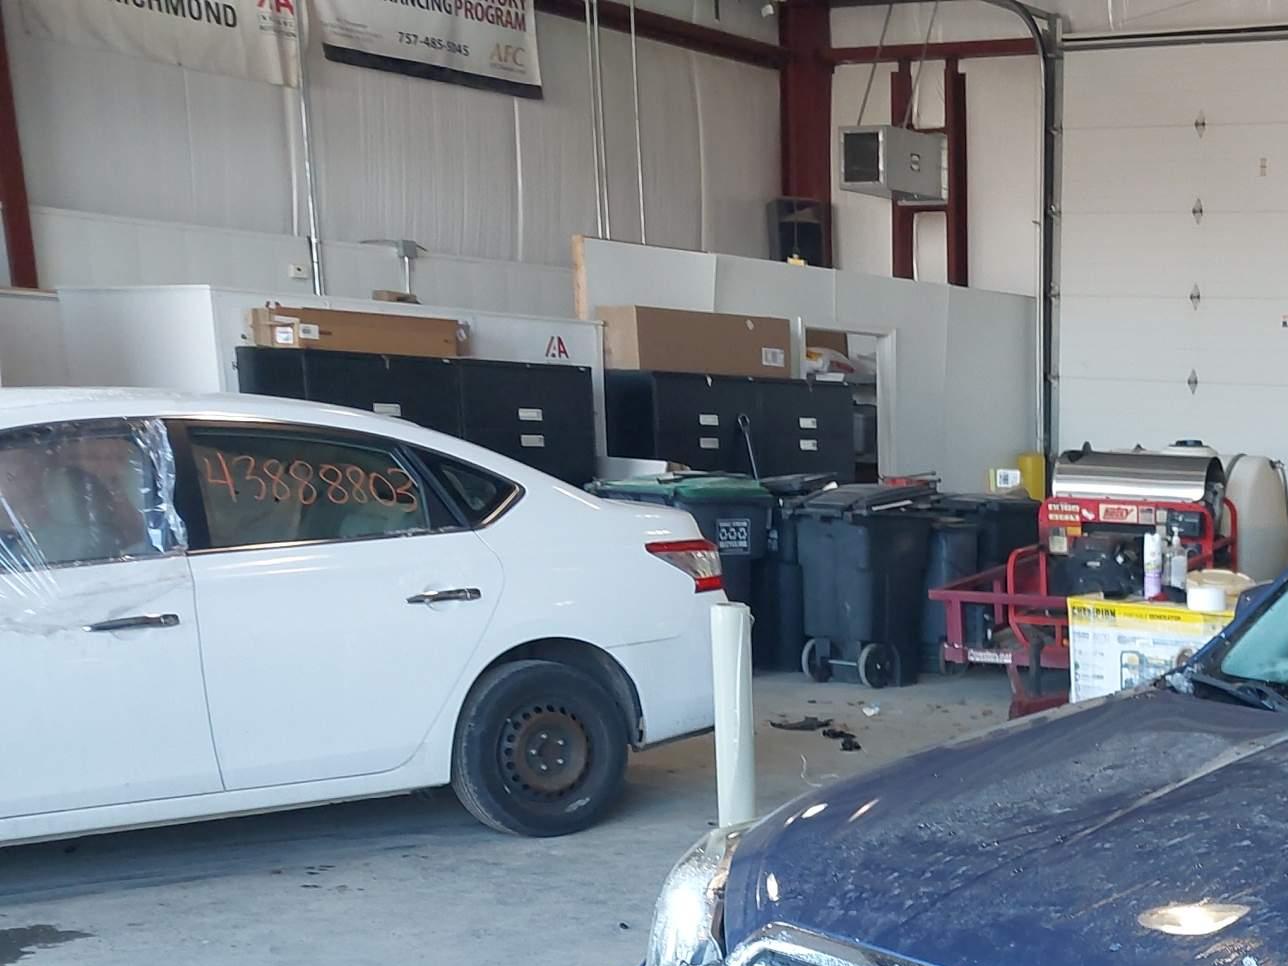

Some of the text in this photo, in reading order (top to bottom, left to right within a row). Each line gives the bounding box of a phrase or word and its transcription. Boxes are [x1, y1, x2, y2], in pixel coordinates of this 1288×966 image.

[455, 0, 526, 32] PROGRAM
[489, 42, 526, 67] AFC
[203, 453, 418, 513] 43888803
